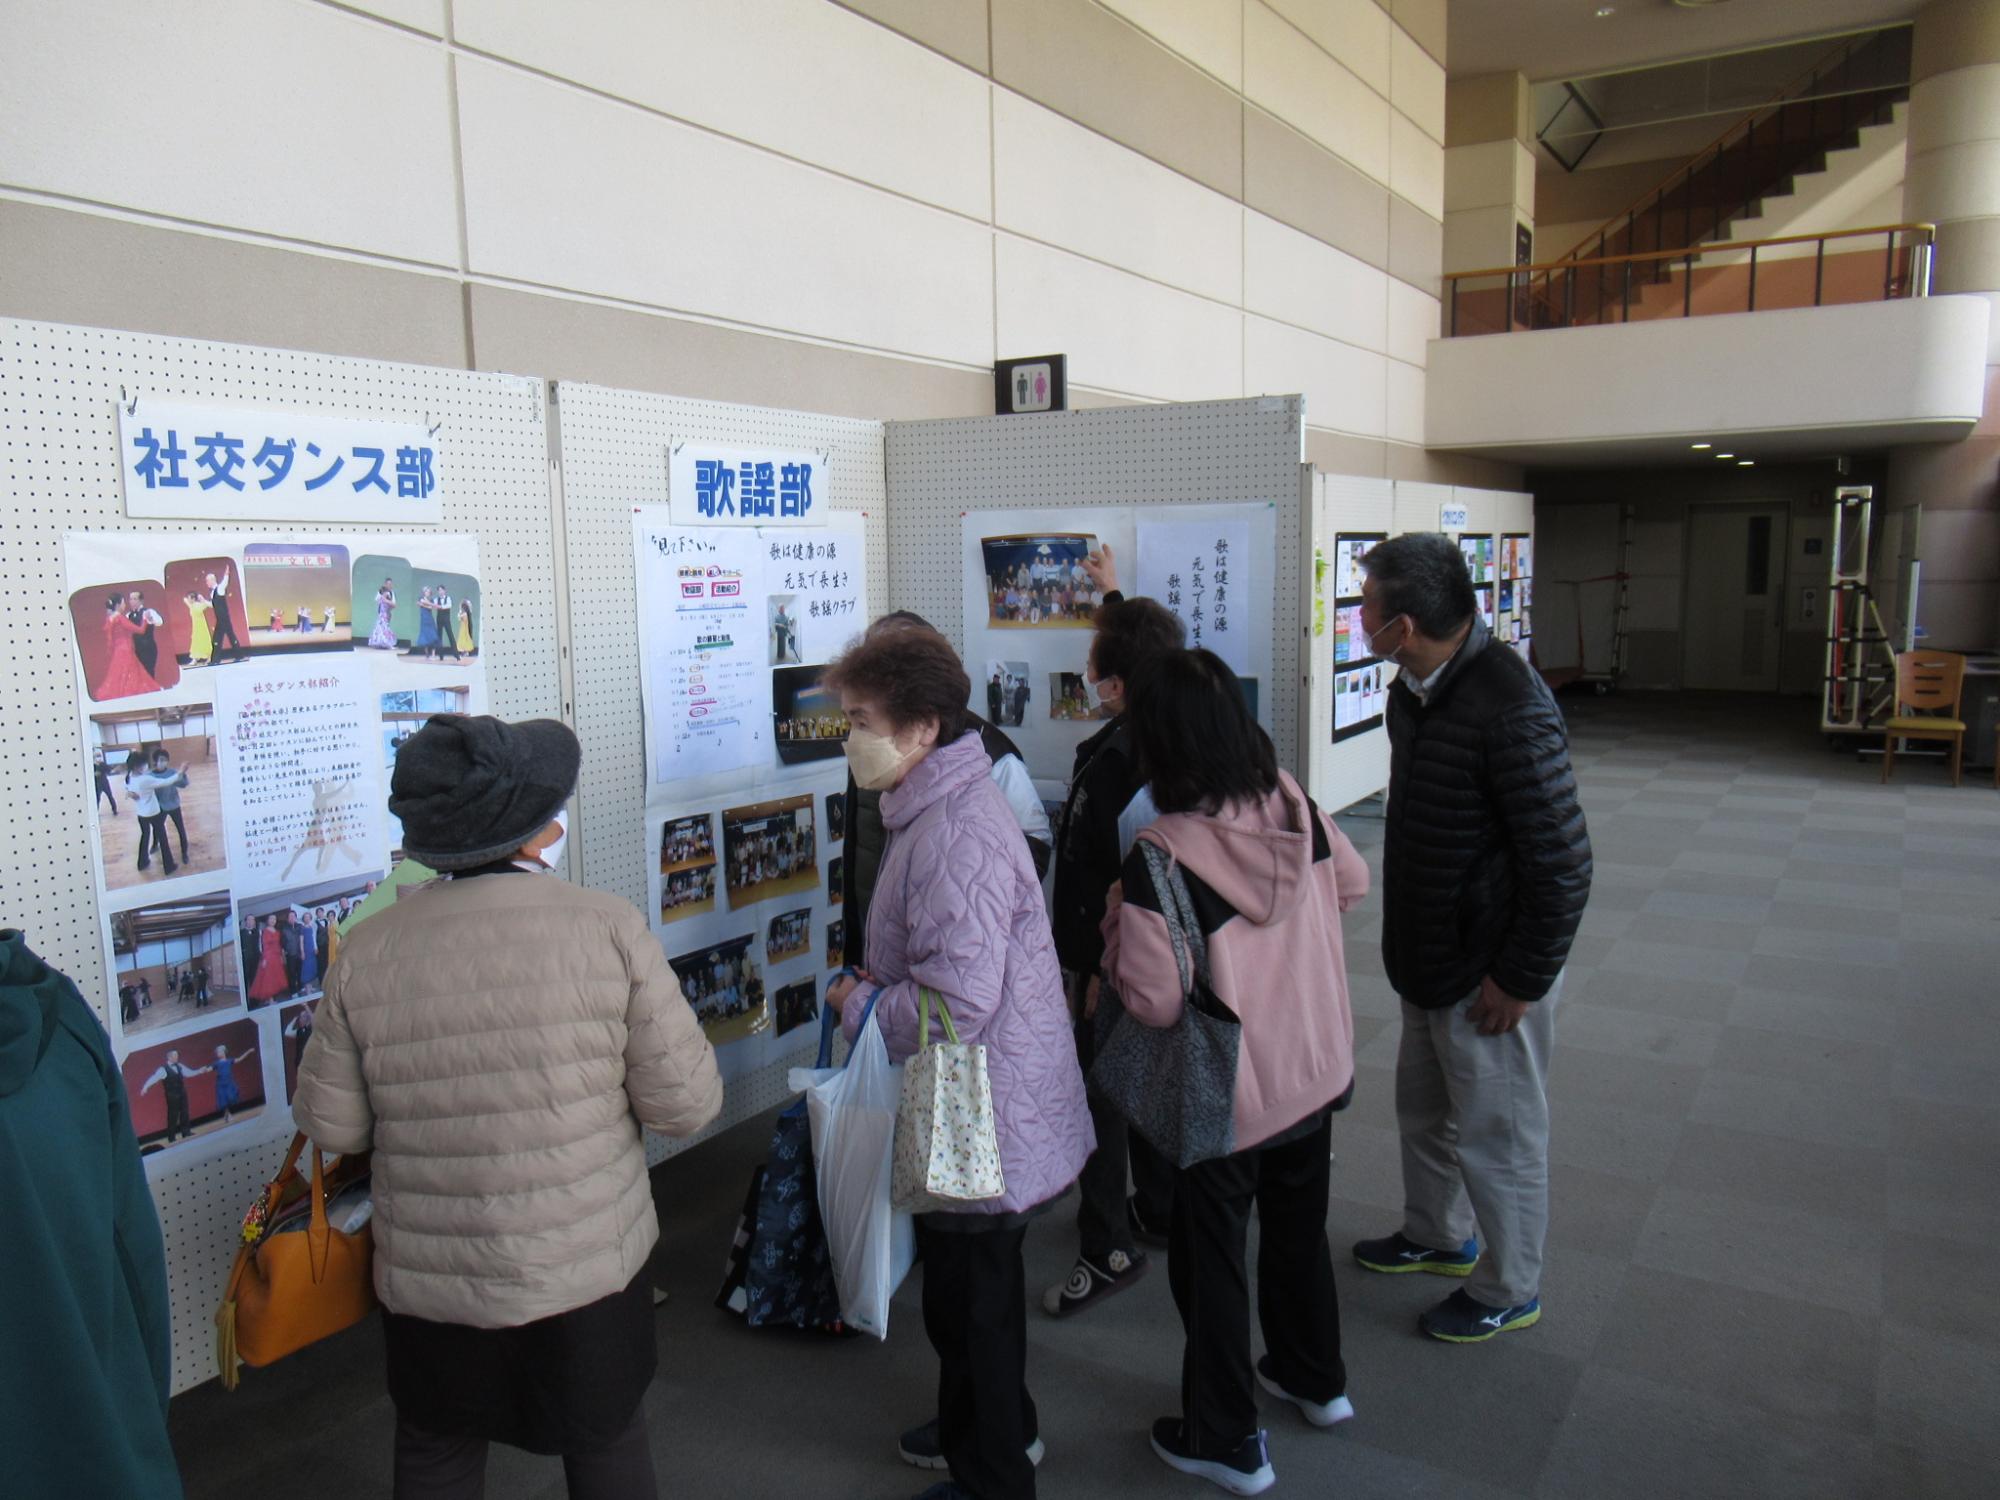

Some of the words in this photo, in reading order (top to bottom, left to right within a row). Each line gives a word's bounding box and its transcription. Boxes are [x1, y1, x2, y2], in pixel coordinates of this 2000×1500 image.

[134, 428, 435, 498] 社交ダンス部
[696, 460, 812, 518] 歌謡部
[770, 541, 838, 561] 歌は健康の源
[784, 570, 849, 590] 元気で長生き
[1214, 538, 1229, 632] 歌は健康の源
[809, 597, 857, 618] 歌謡クラブ
[253, 676, 341, 694] 社交ダンス部紹介
